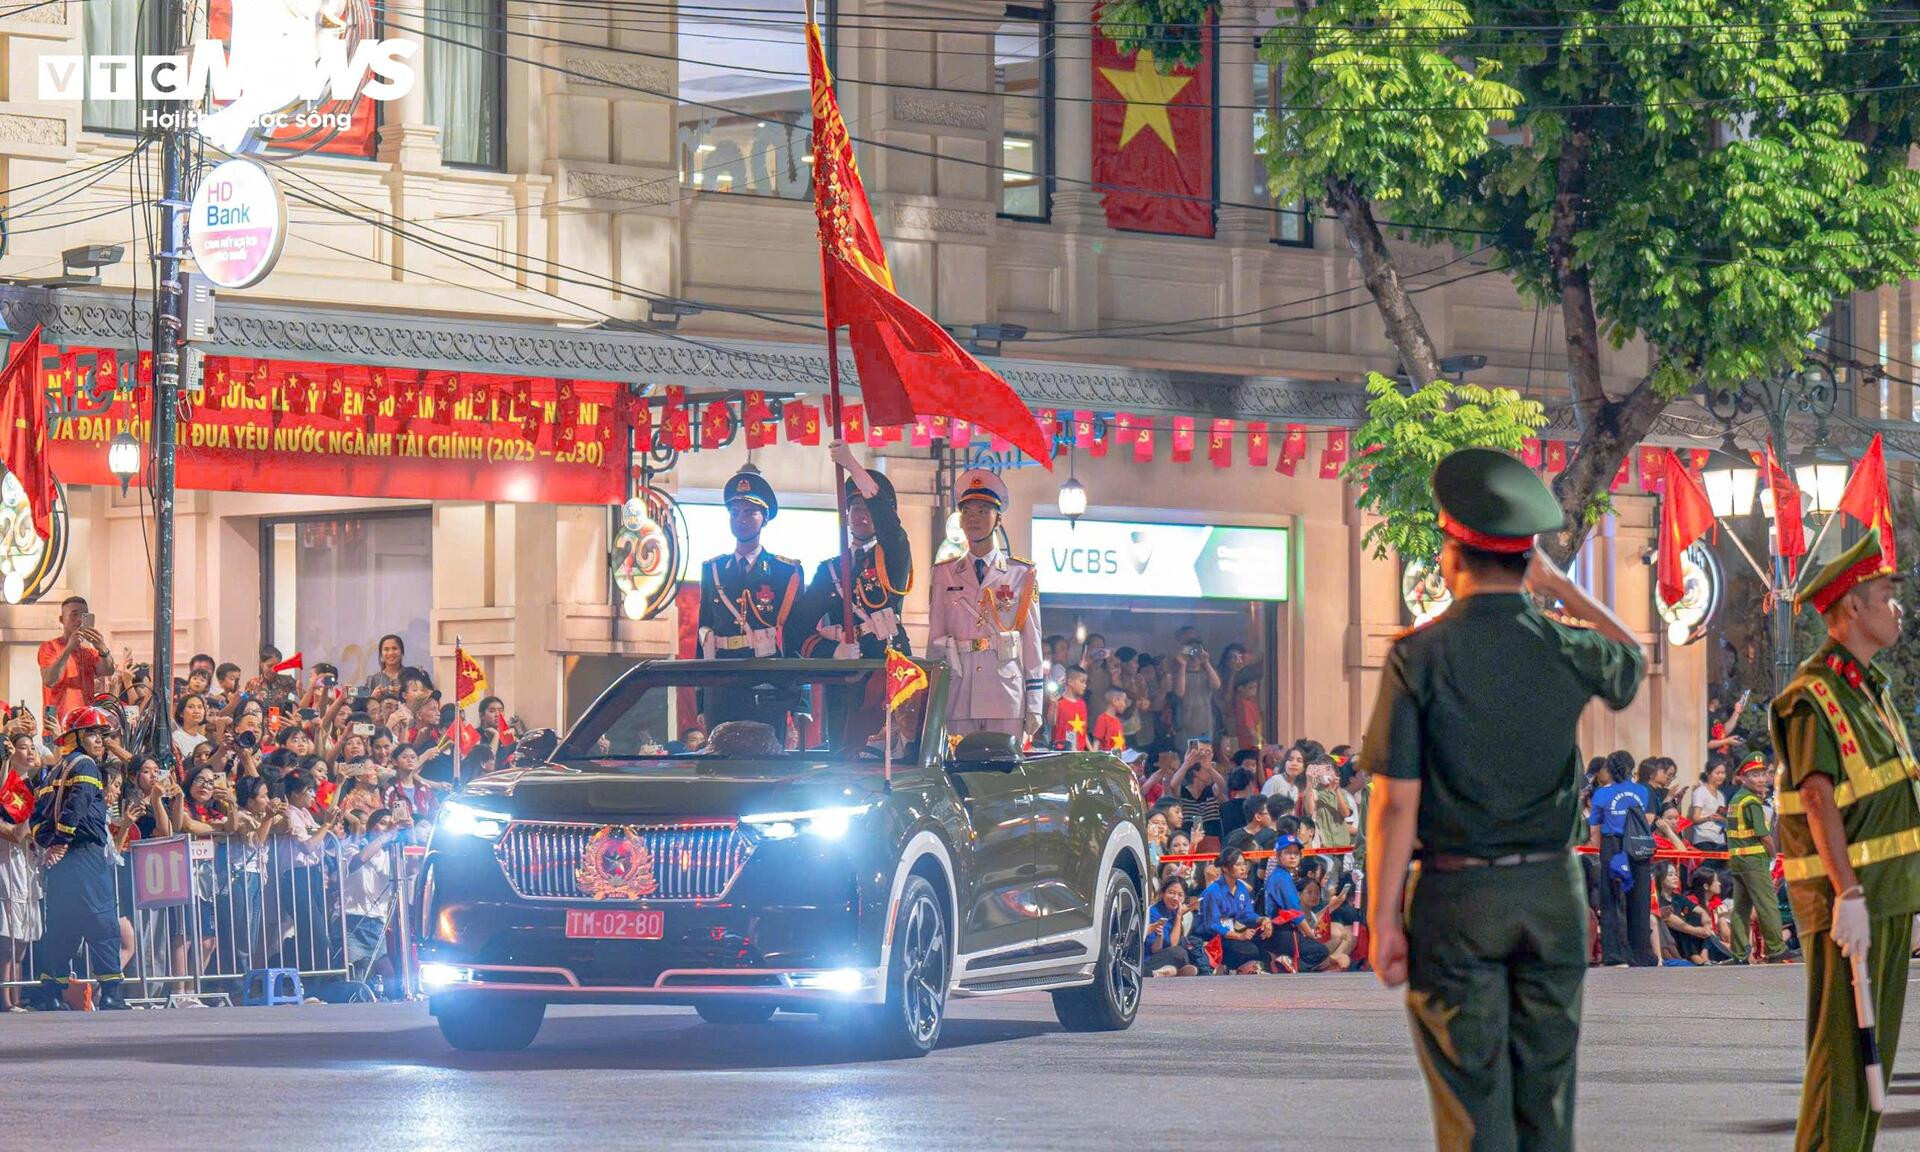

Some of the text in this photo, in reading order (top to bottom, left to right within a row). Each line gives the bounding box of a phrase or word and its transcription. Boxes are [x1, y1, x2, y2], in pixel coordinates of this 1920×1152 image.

[208, 181, 232, 203] HD
[207, 203, 250, 226] Bank
[78, 416, 111, 448] ĐẠI
[191, 423, 230, 449] ĐUA
[234, 421, 269, 450] YÊU
[274, 424, 325, 454] NƯỚC
[328, 427, 392, 456] NGÀNH
[396, 430, 423, 458] TÀI
[428, 431, 483, 460] CHÍNH
[487, 435, 535, 464] (2025
[1052, 548, 1118, 574] VCBS
[571, 912, 660, 936] TM-02-80
